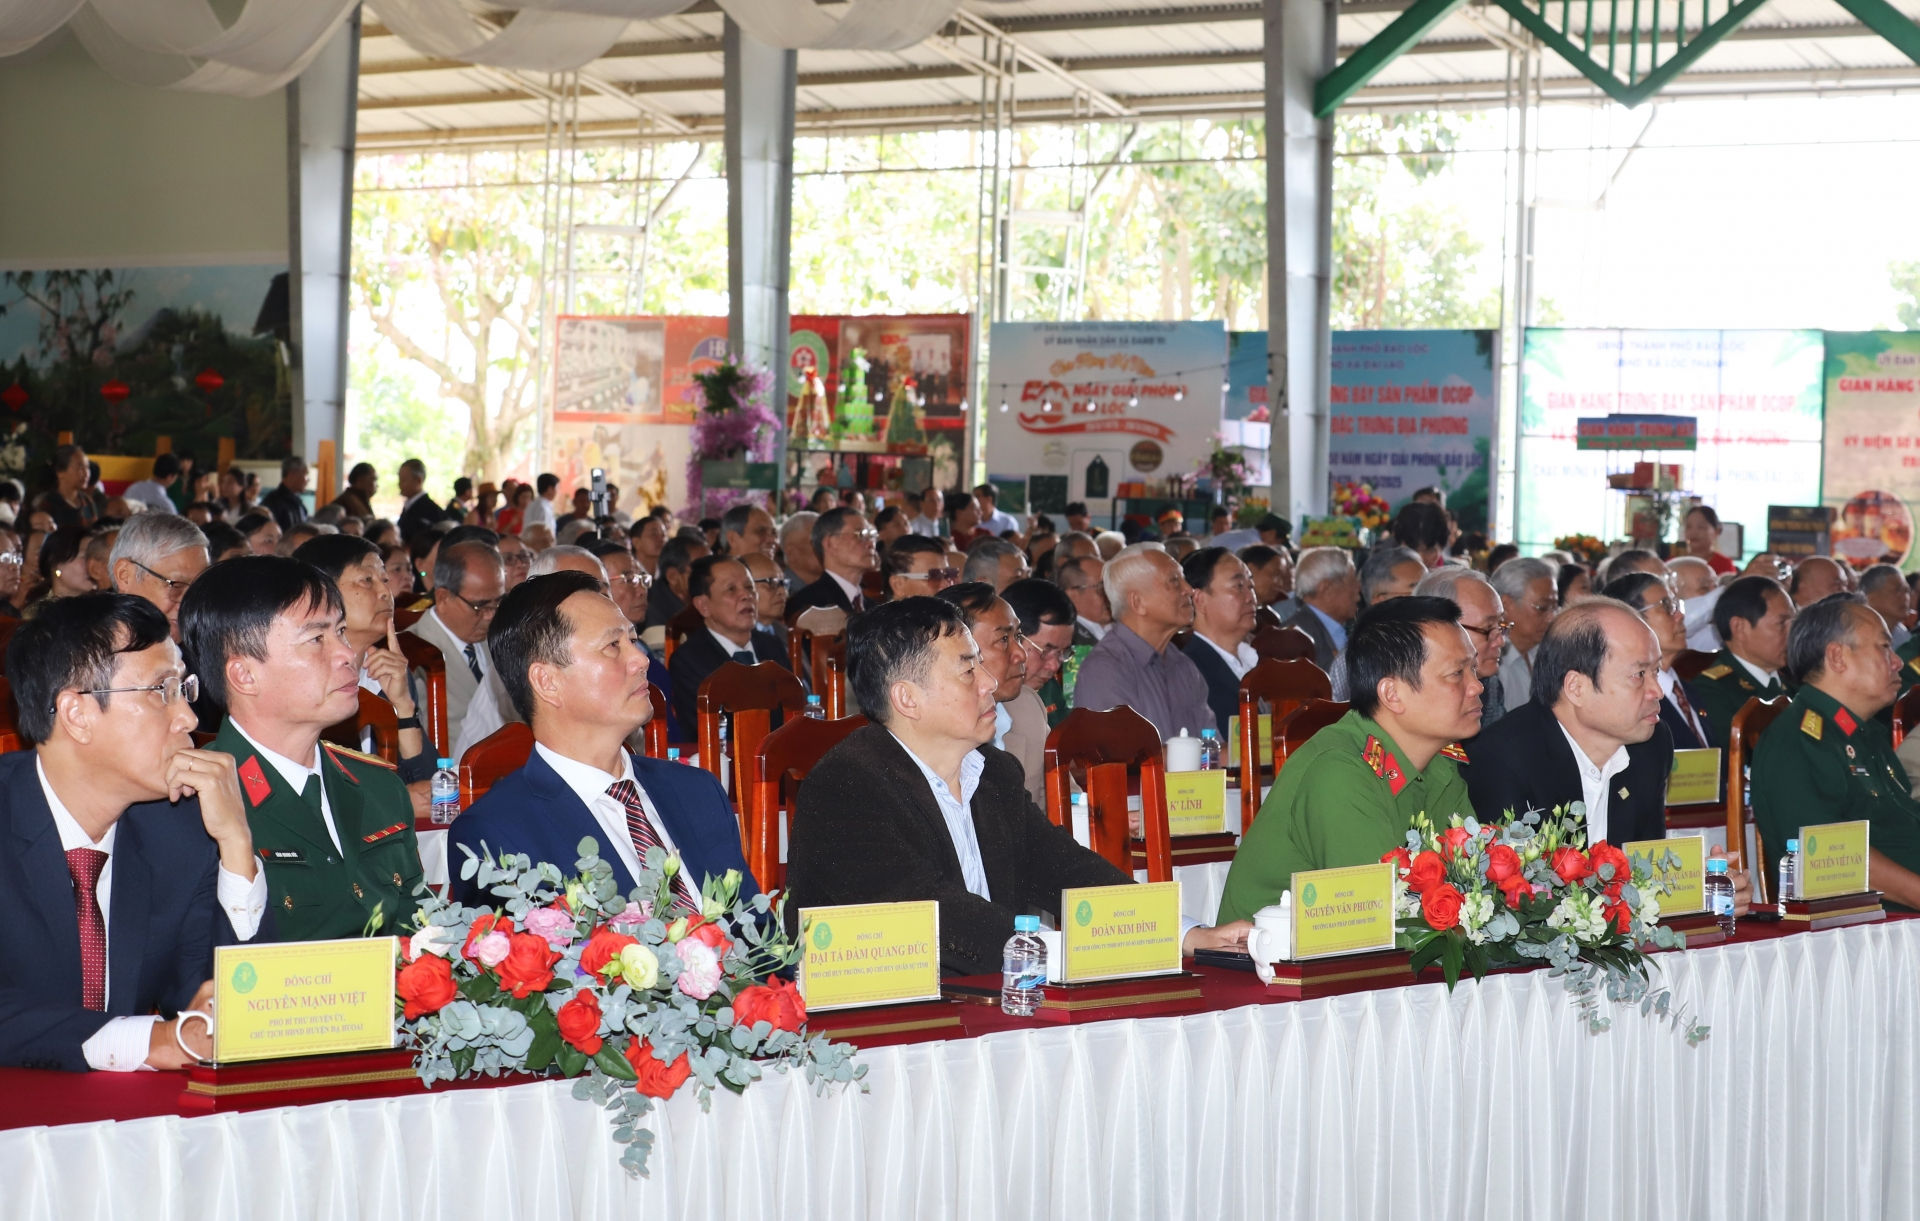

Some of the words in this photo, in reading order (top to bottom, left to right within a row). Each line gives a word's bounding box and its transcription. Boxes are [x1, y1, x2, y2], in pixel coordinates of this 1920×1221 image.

[1839, 379, 1872, 392] GIAN
[1876, 377, 1914, 392] HÀNG
[1305, 903, 1335, 918] NGUYỄN
[1091, 923, 1115, 938] ĐOÀN
[1117, 923, 1134, 935] KIM
[810, 951, 828, 966] ĐẠI
[831, 947, 844, 962] TÁ
[846, 946, 868, 961] ĐÀM
[871, 944, 905, 961] QUANG
[908, 941, 929, 956] ĐỨC
[284, 973, 312, 987] ĐỒNG
[314, 972, 332, 985] CHÍ
[248, 993, 298, 1012] NGUYỄN
[301, 993, 337, 1010] MẠNH
[339, 991, 367, 1006] VIỆT
[269, 1018, 283, 1027] PHÓ
